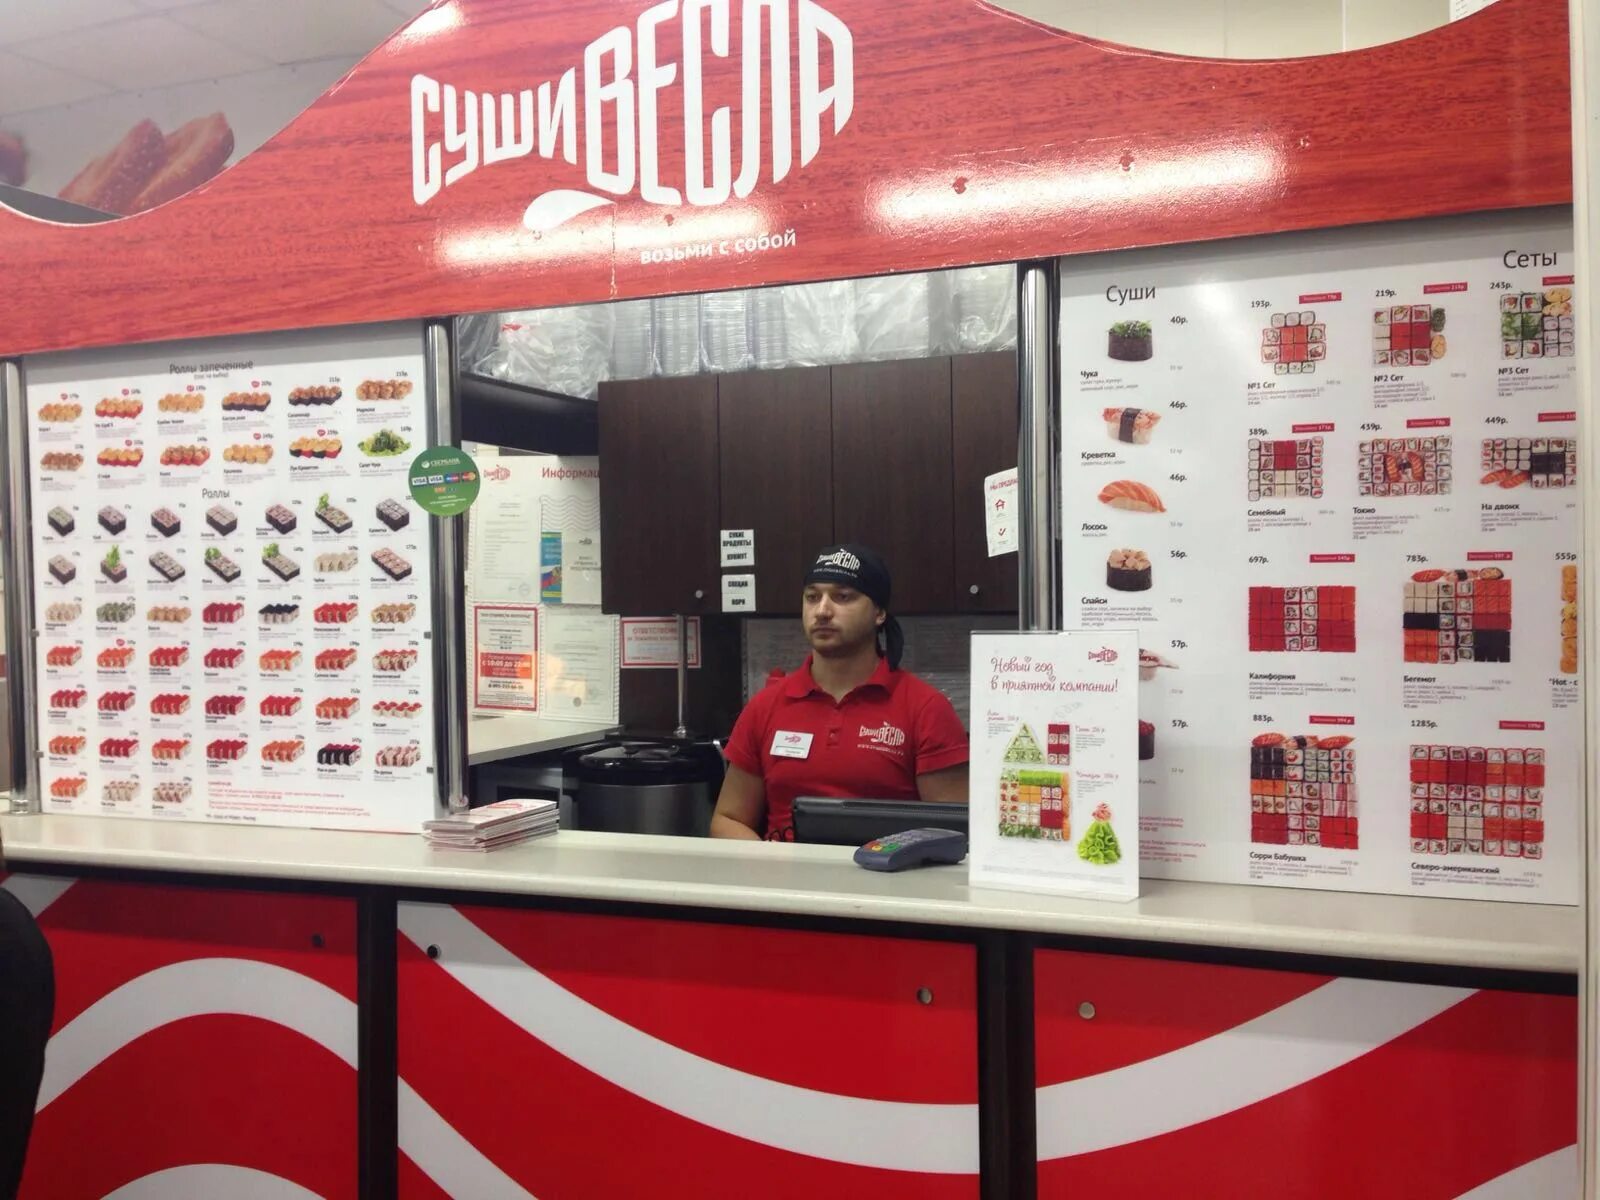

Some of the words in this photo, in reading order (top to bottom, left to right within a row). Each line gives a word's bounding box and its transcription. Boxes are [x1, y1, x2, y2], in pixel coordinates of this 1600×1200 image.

[640, 243, 713, 265] возьми
[719, 243, 729, 256] с
[735, 229, 797, 253] собой
[1503, 250, 1557, 268] Сеты
[1490, 281, 1512, 290] 243р.
[1106, 285, 1156, 305] Суши
[1375, 289, 1397, 298] 219р.
[1251, 300, 1272, 308] 193р.
[1170, 315, 1188, 325] 40р.
[169, 363, 197, 375] Роллы
[199, 360, 253, 373] запеченные
[1080, 370, 1098, 379] Чука
[1390, 374, 1404, 382] Сет
[1247, 382, 1261, 390] №1
[1263, 381, 1276, 389] Сет
[1169, 401, 1188, 410] 46р.
[1485, 416, 1509, 425] 449р.
[1360, 423, 1383, 431] 439р.
[1081, 451, 1116, 460] Креветка
[1169, 473, 1188, 482] 46р.
[201, 488, 230, 499] Роллы
[1494, 503, 1520, 511] двоих
[1248, 508, 1286, 516] Семейный
[1081, 523, 1108, 531] Лосось
[722, 539, 752, 547] ПРОДУКТЫ
[1170, 550, 1188, 558] 56р.
[1248, 556, 1269, 564] 697р.
[1406, 555, 1429, 563] 783р.
[1171, 640, 1188, 649] 57р.
[990, 656, 1031, 674] Новый
[1034, 662, 1054, 676] год
[1249, 672, 1296, 681] Калифорния
[1403, 675, 1436, 683] Бегемот
[990, 676, 998, 691] в
[1002, 675, 1056, 694] приятной
[1059, 679, 1119, 693] компании!
[1253, 714, 1274, 723] 883р.
[1171, 719, 1189, 728] 57р.
[1411, 719, 1438, 728] 1285р.
[1250, 851, 1273, 861] Сорри
[1274, 853, 1307, 863] Бабушка
[1411, 862, 1500, 874] Северо-американский
